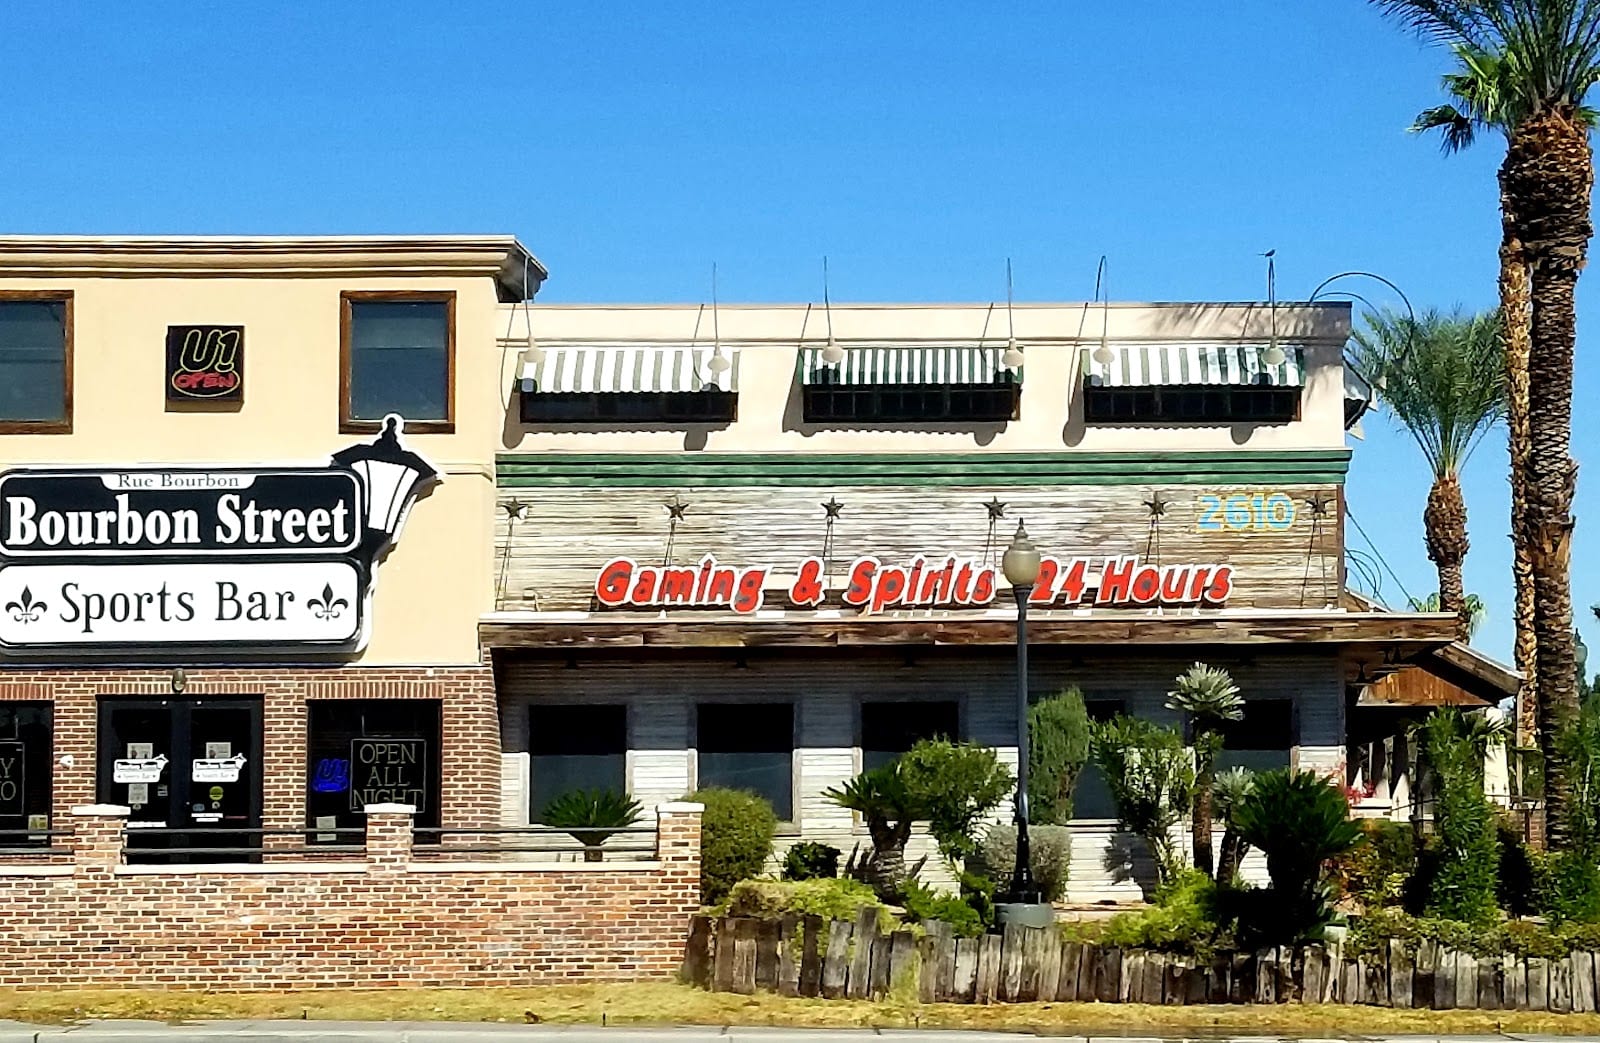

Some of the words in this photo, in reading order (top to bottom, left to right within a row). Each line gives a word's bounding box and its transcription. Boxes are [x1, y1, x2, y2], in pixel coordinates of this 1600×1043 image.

[174, 370, 235, 389] OPEN
[118, 474, 153, 488] Rue
[160, 474, 240, 488] Bourbon
[5, 493, 201, 546] Bourbon
[215, 493, 349, 544] Street
[1198, 493, 1296, 532] 2610
[595, 554, 770, 613] Gaming
[789, 556, 825, 606] &
[844, 554, 999, 615] Spirits
[1028, 556, 1088, 604] 24
[1096, 554, 1235, 604] Hours
[59, 580, 196, 633] Sports
[215, 580, 296, 622] Bar
[360, 743, 417, 764] OPEN
[366, 766, 411, 787] ALL
[353, 788, 424, 809] NIGHT
